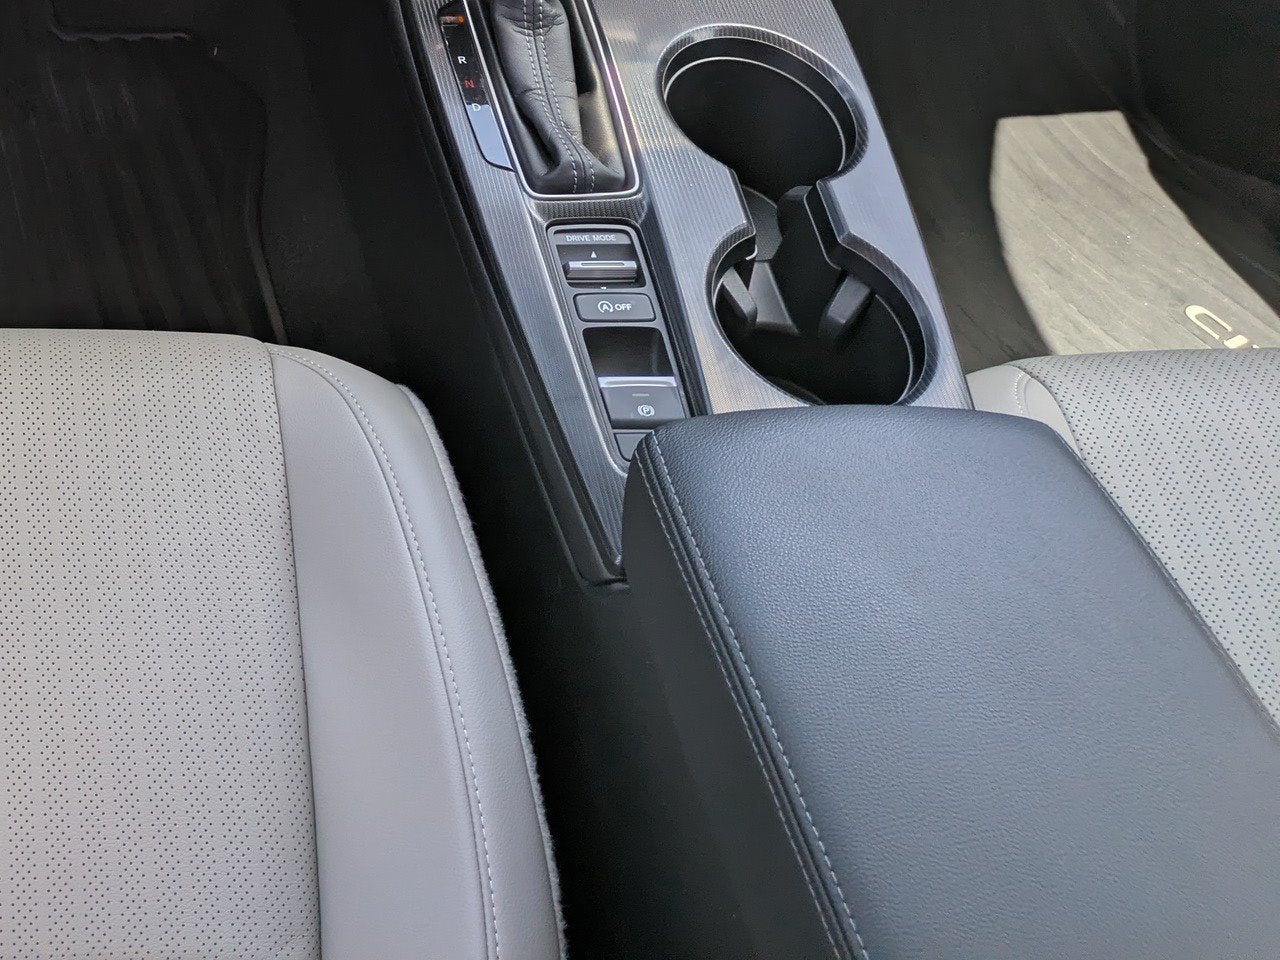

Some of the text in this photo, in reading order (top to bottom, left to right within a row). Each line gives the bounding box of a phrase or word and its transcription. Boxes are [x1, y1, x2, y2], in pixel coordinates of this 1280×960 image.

[458, 56, 467, 65] R
[464, 80, 475, 88] N
[471, 103, 481, 112] D
[615, 303, 632, 311] OFF
